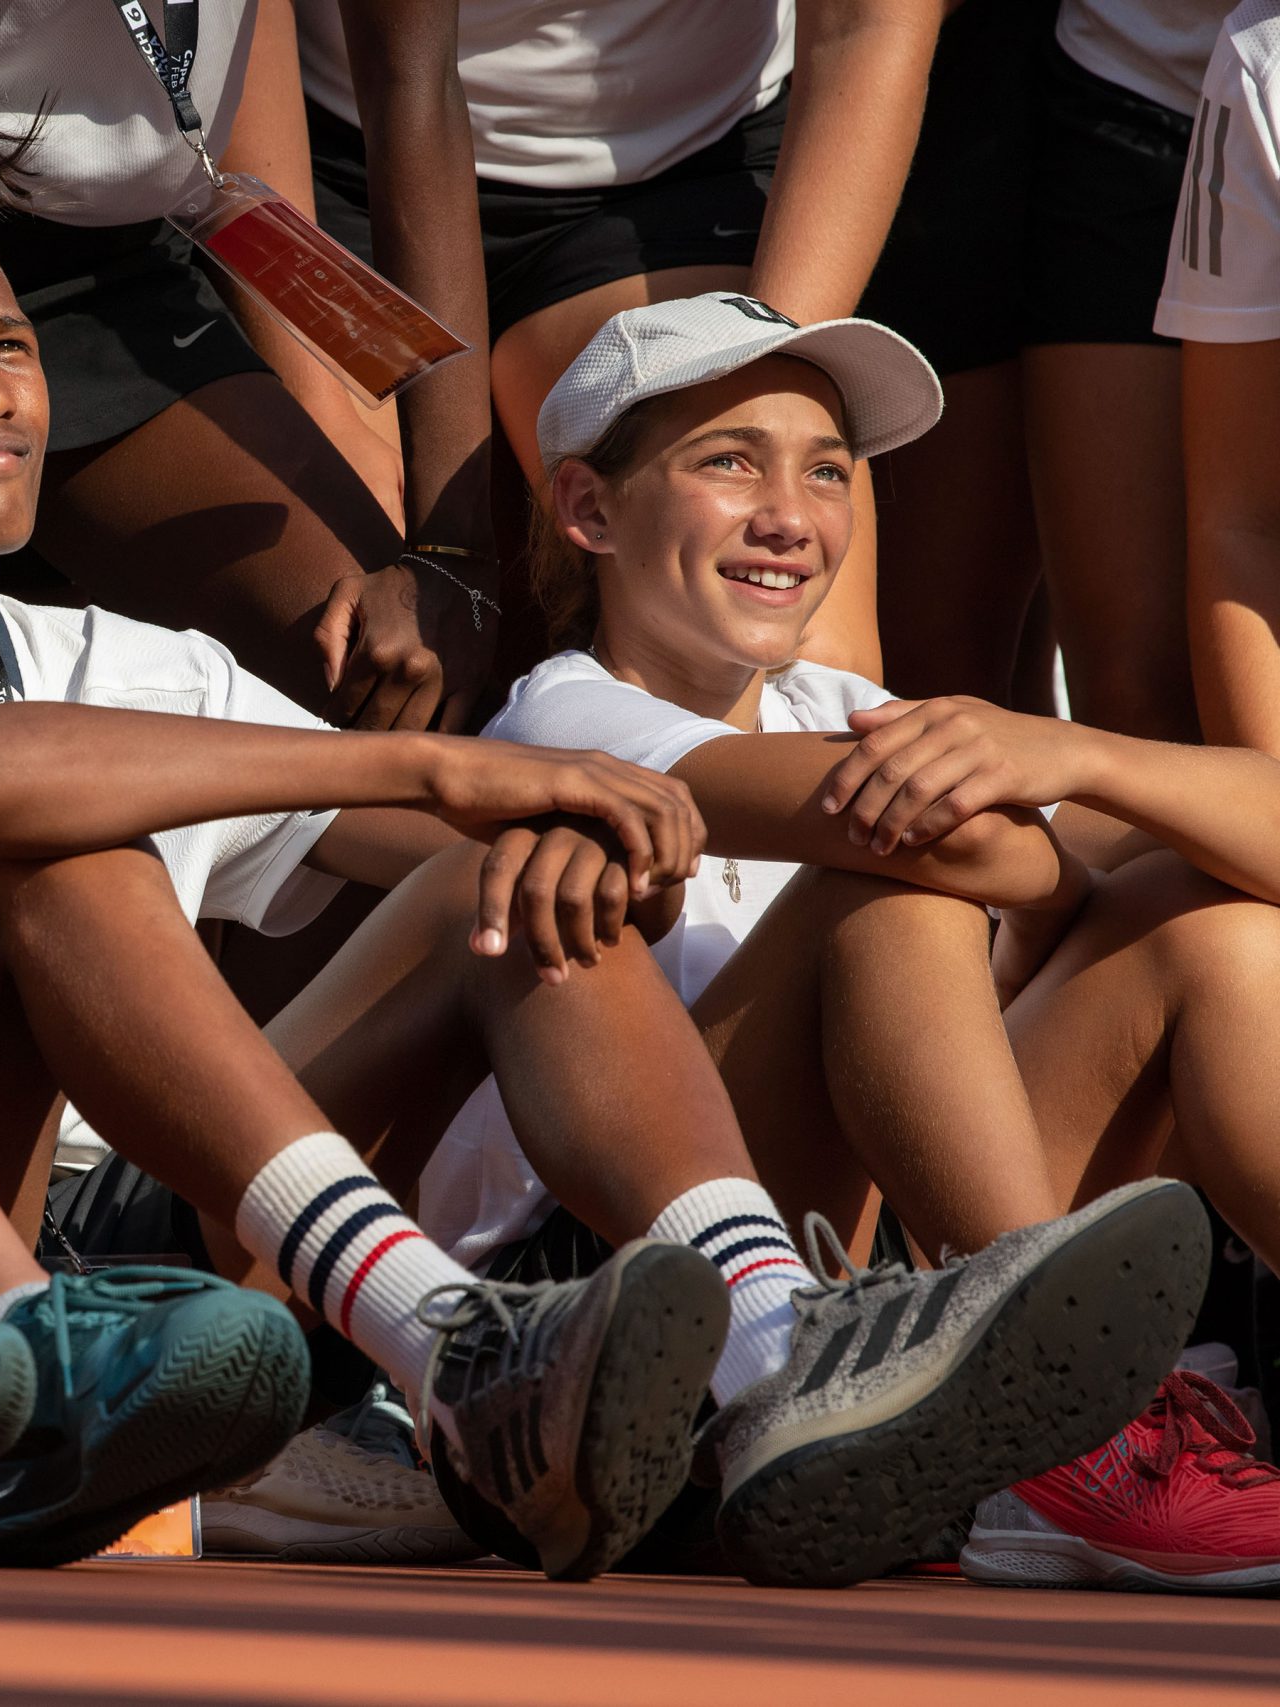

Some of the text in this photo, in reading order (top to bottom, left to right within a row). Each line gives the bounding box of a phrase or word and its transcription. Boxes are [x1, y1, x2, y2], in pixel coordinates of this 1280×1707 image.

[127, 7, 141, 22] 6
[171, 67, 180, 88] FEB
[179, 50, 193, 84] Cape
